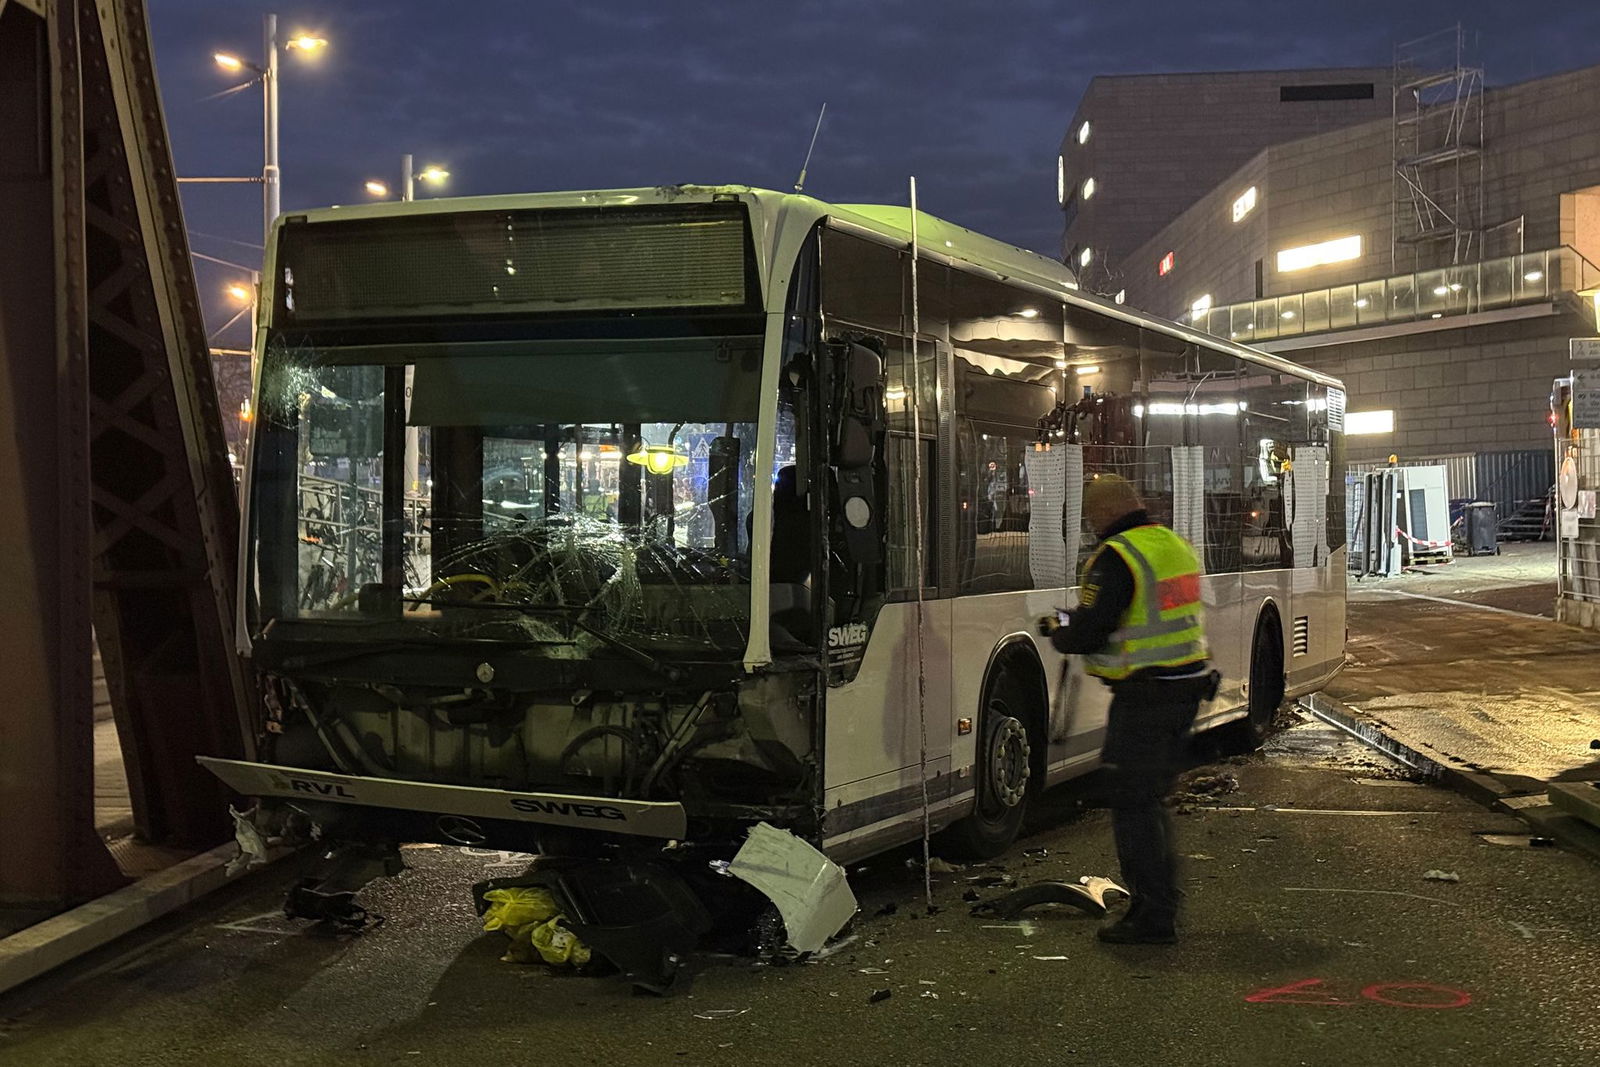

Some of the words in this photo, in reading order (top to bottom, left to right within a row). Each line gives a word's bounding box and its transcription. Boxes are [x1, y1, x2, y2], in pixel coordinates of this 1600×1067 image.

[828, 624, 867, 647] SWEG
[290, 779, 356, 799] RVL
[509, 798, 627, 822] SWEG
